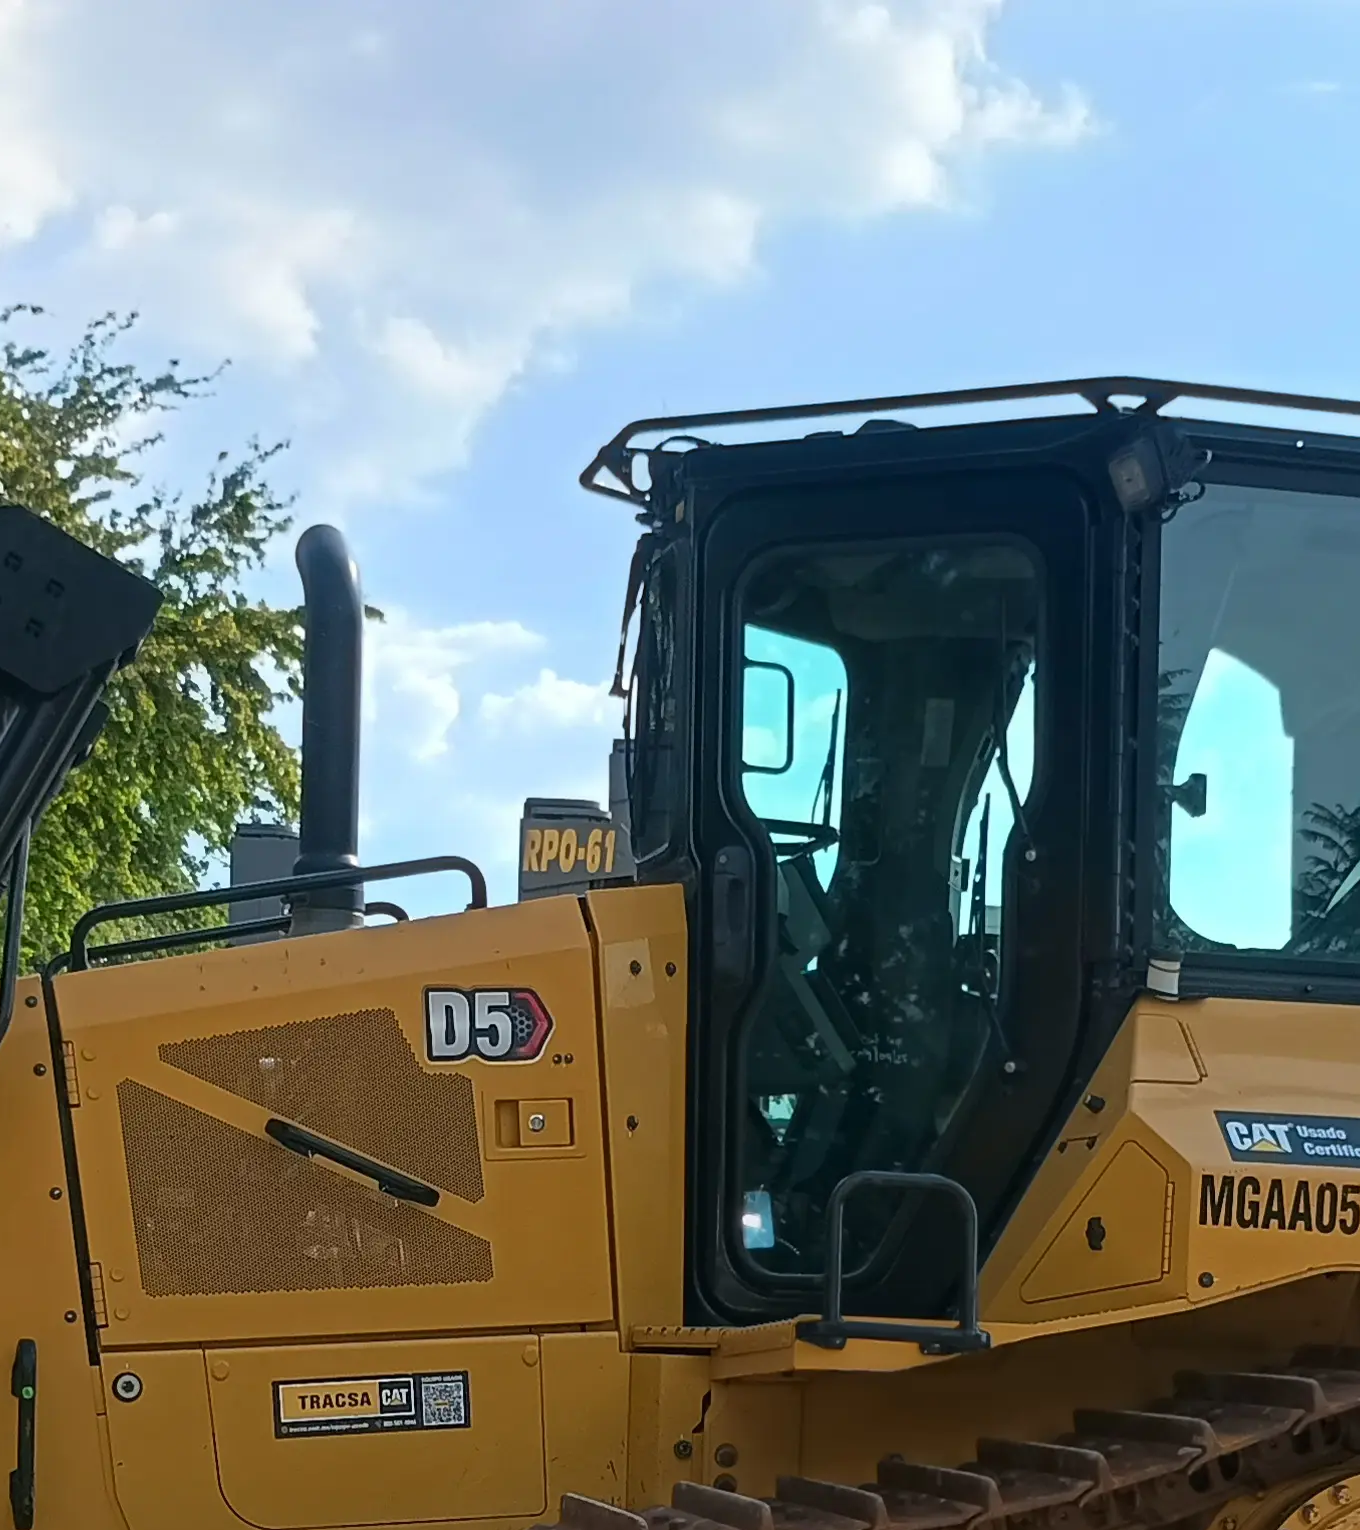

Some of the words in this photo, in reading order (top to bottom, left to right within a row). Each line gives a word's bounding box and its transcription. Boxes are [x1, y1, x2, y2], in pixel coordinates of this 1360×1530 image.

[522, 828, 615, 873] RPO-61
[428, 991, 513, 1058] D5
[1225, 1121, 1292, 1153] CAT
[1296, 1124, 1347, 1140] Usado
[298, 1392, 372, 1410] TRACSA
[381, 1388, 409, 1406] CAT
